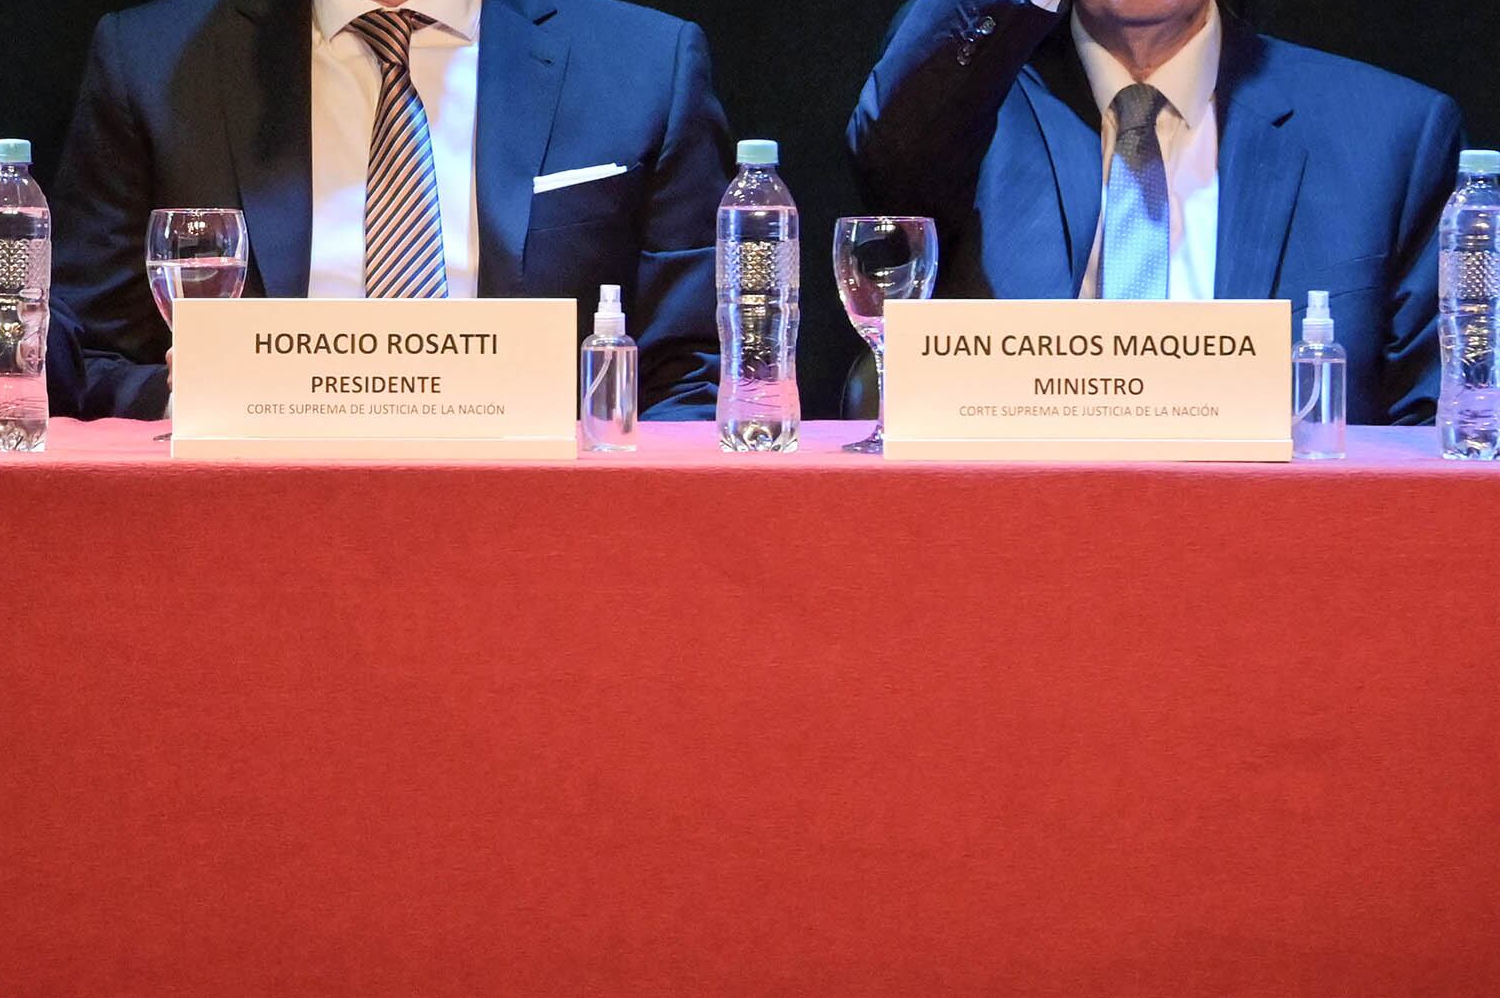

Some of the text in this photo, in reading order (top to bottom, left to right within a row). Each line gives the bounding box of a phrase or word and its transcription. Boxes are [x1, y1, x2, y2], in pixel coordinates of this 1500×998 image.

[256, 333, 497, 354] HORACIO ROSATTI
[921, 335, 1256, 359] JUAN CARLOS MAQUEDA
[312, 376, 441, 393] PRESIDENTE
[1034, 378, 1144, 395] MINISTRO
[246, 402, 505, 415] CORTE SUPREMA DE JUSTICIA DE LA NACIÓN
[959, 404, 1219, 417] CORTE SUPREMA DE JUSTICIA DE LA NACIÓN
